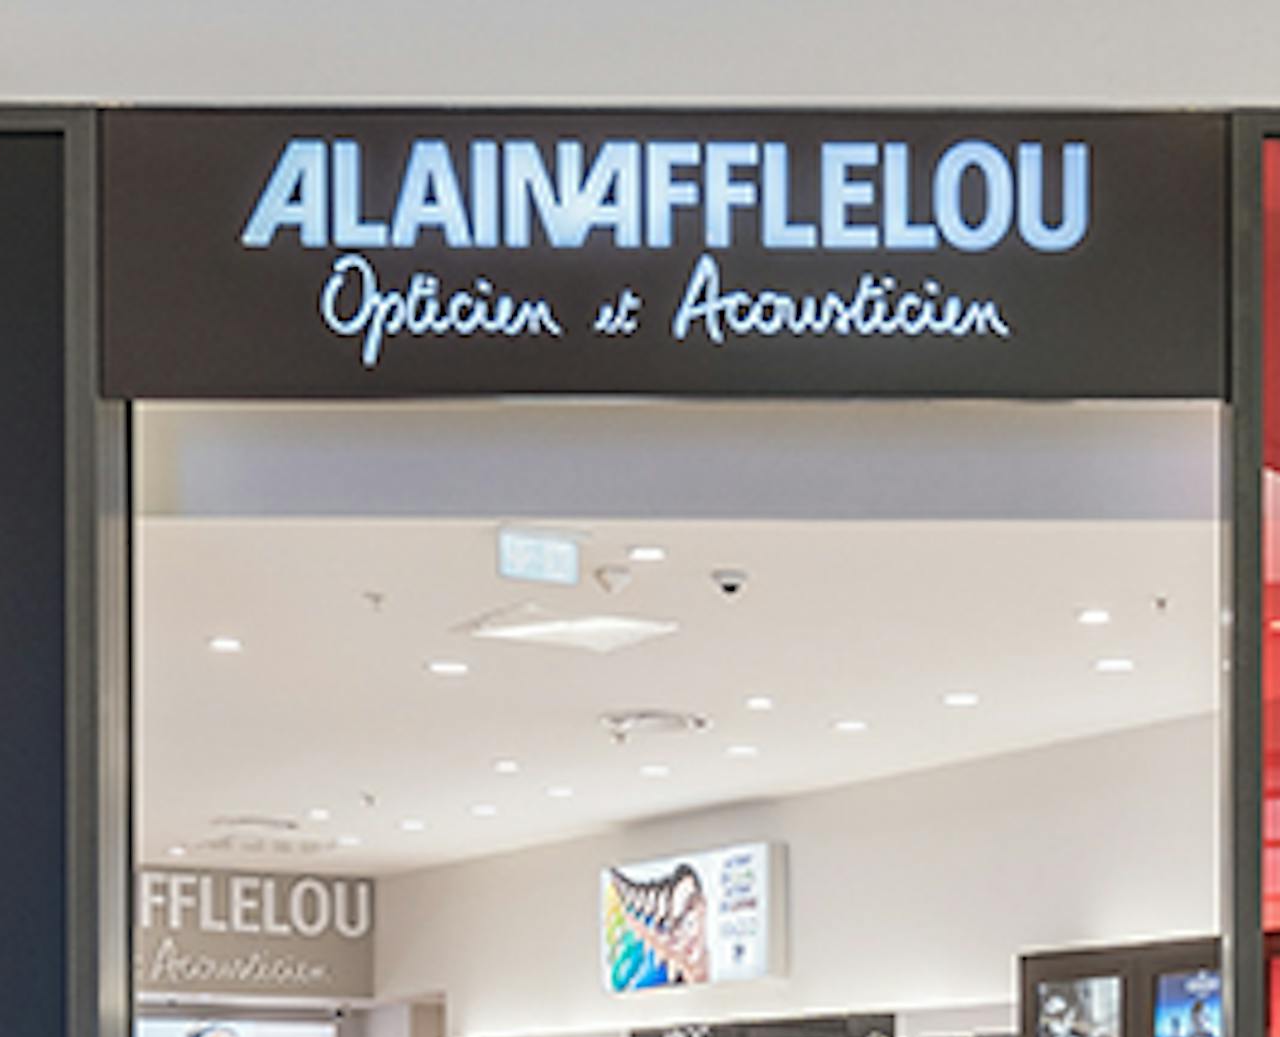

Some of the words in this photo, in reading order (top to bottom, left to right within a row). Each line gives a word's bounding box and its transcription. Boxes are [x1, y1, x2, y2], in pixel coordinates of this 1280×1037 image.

[320, 251, 564, 365] Opticien
[593, 285, 643, 334] et
[672, 251, 1011, 345] Acousticien
[139, 870, 370, 938] FFLELOU
